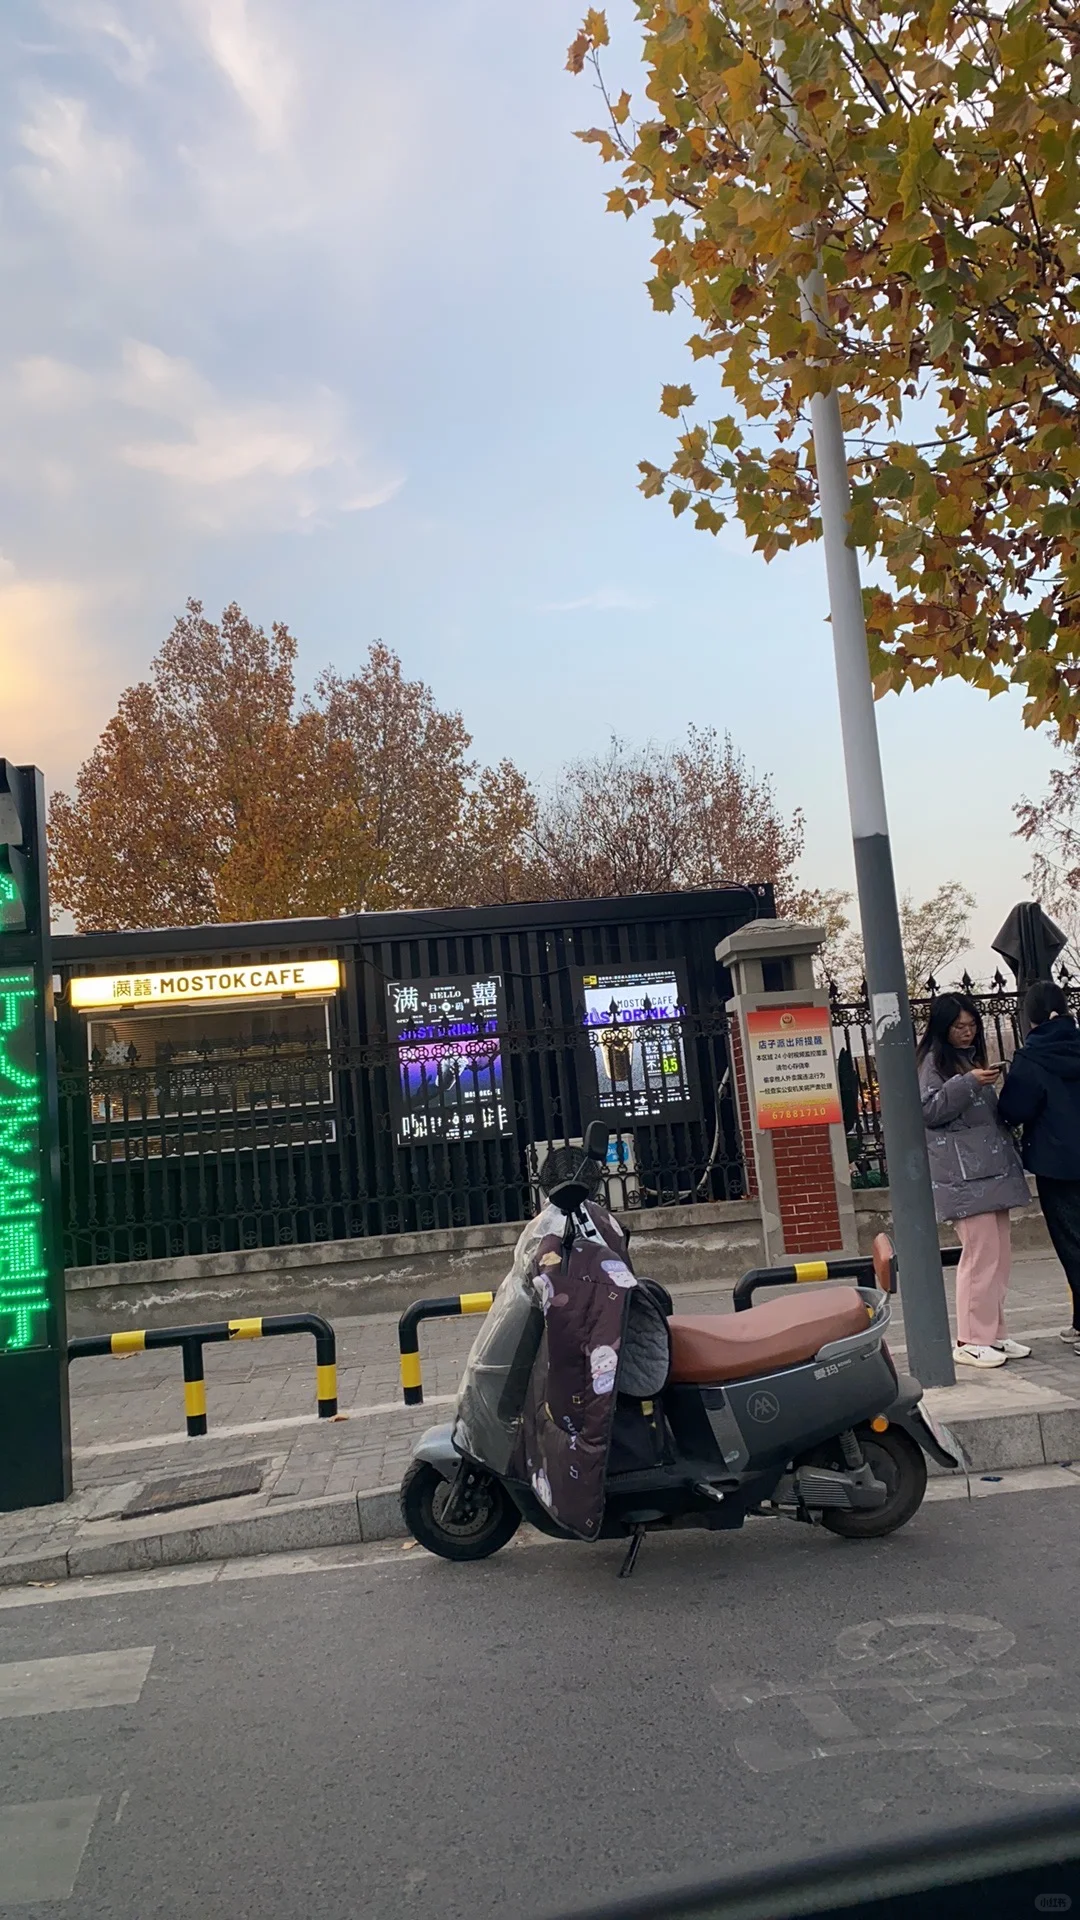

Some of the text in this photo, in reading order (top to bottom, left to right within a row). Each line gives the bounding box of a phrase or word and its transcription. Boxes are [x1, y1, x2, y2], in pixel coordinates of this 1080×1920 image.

[160, 972, 246, 994] MOSTOK
[250, 967, 305, 988] CAFE
[393, 986, 419, 1013] 满
[429, 990, 462, 999] HELLO
[617, 995, 673, 1009] MOSTO CAFE
